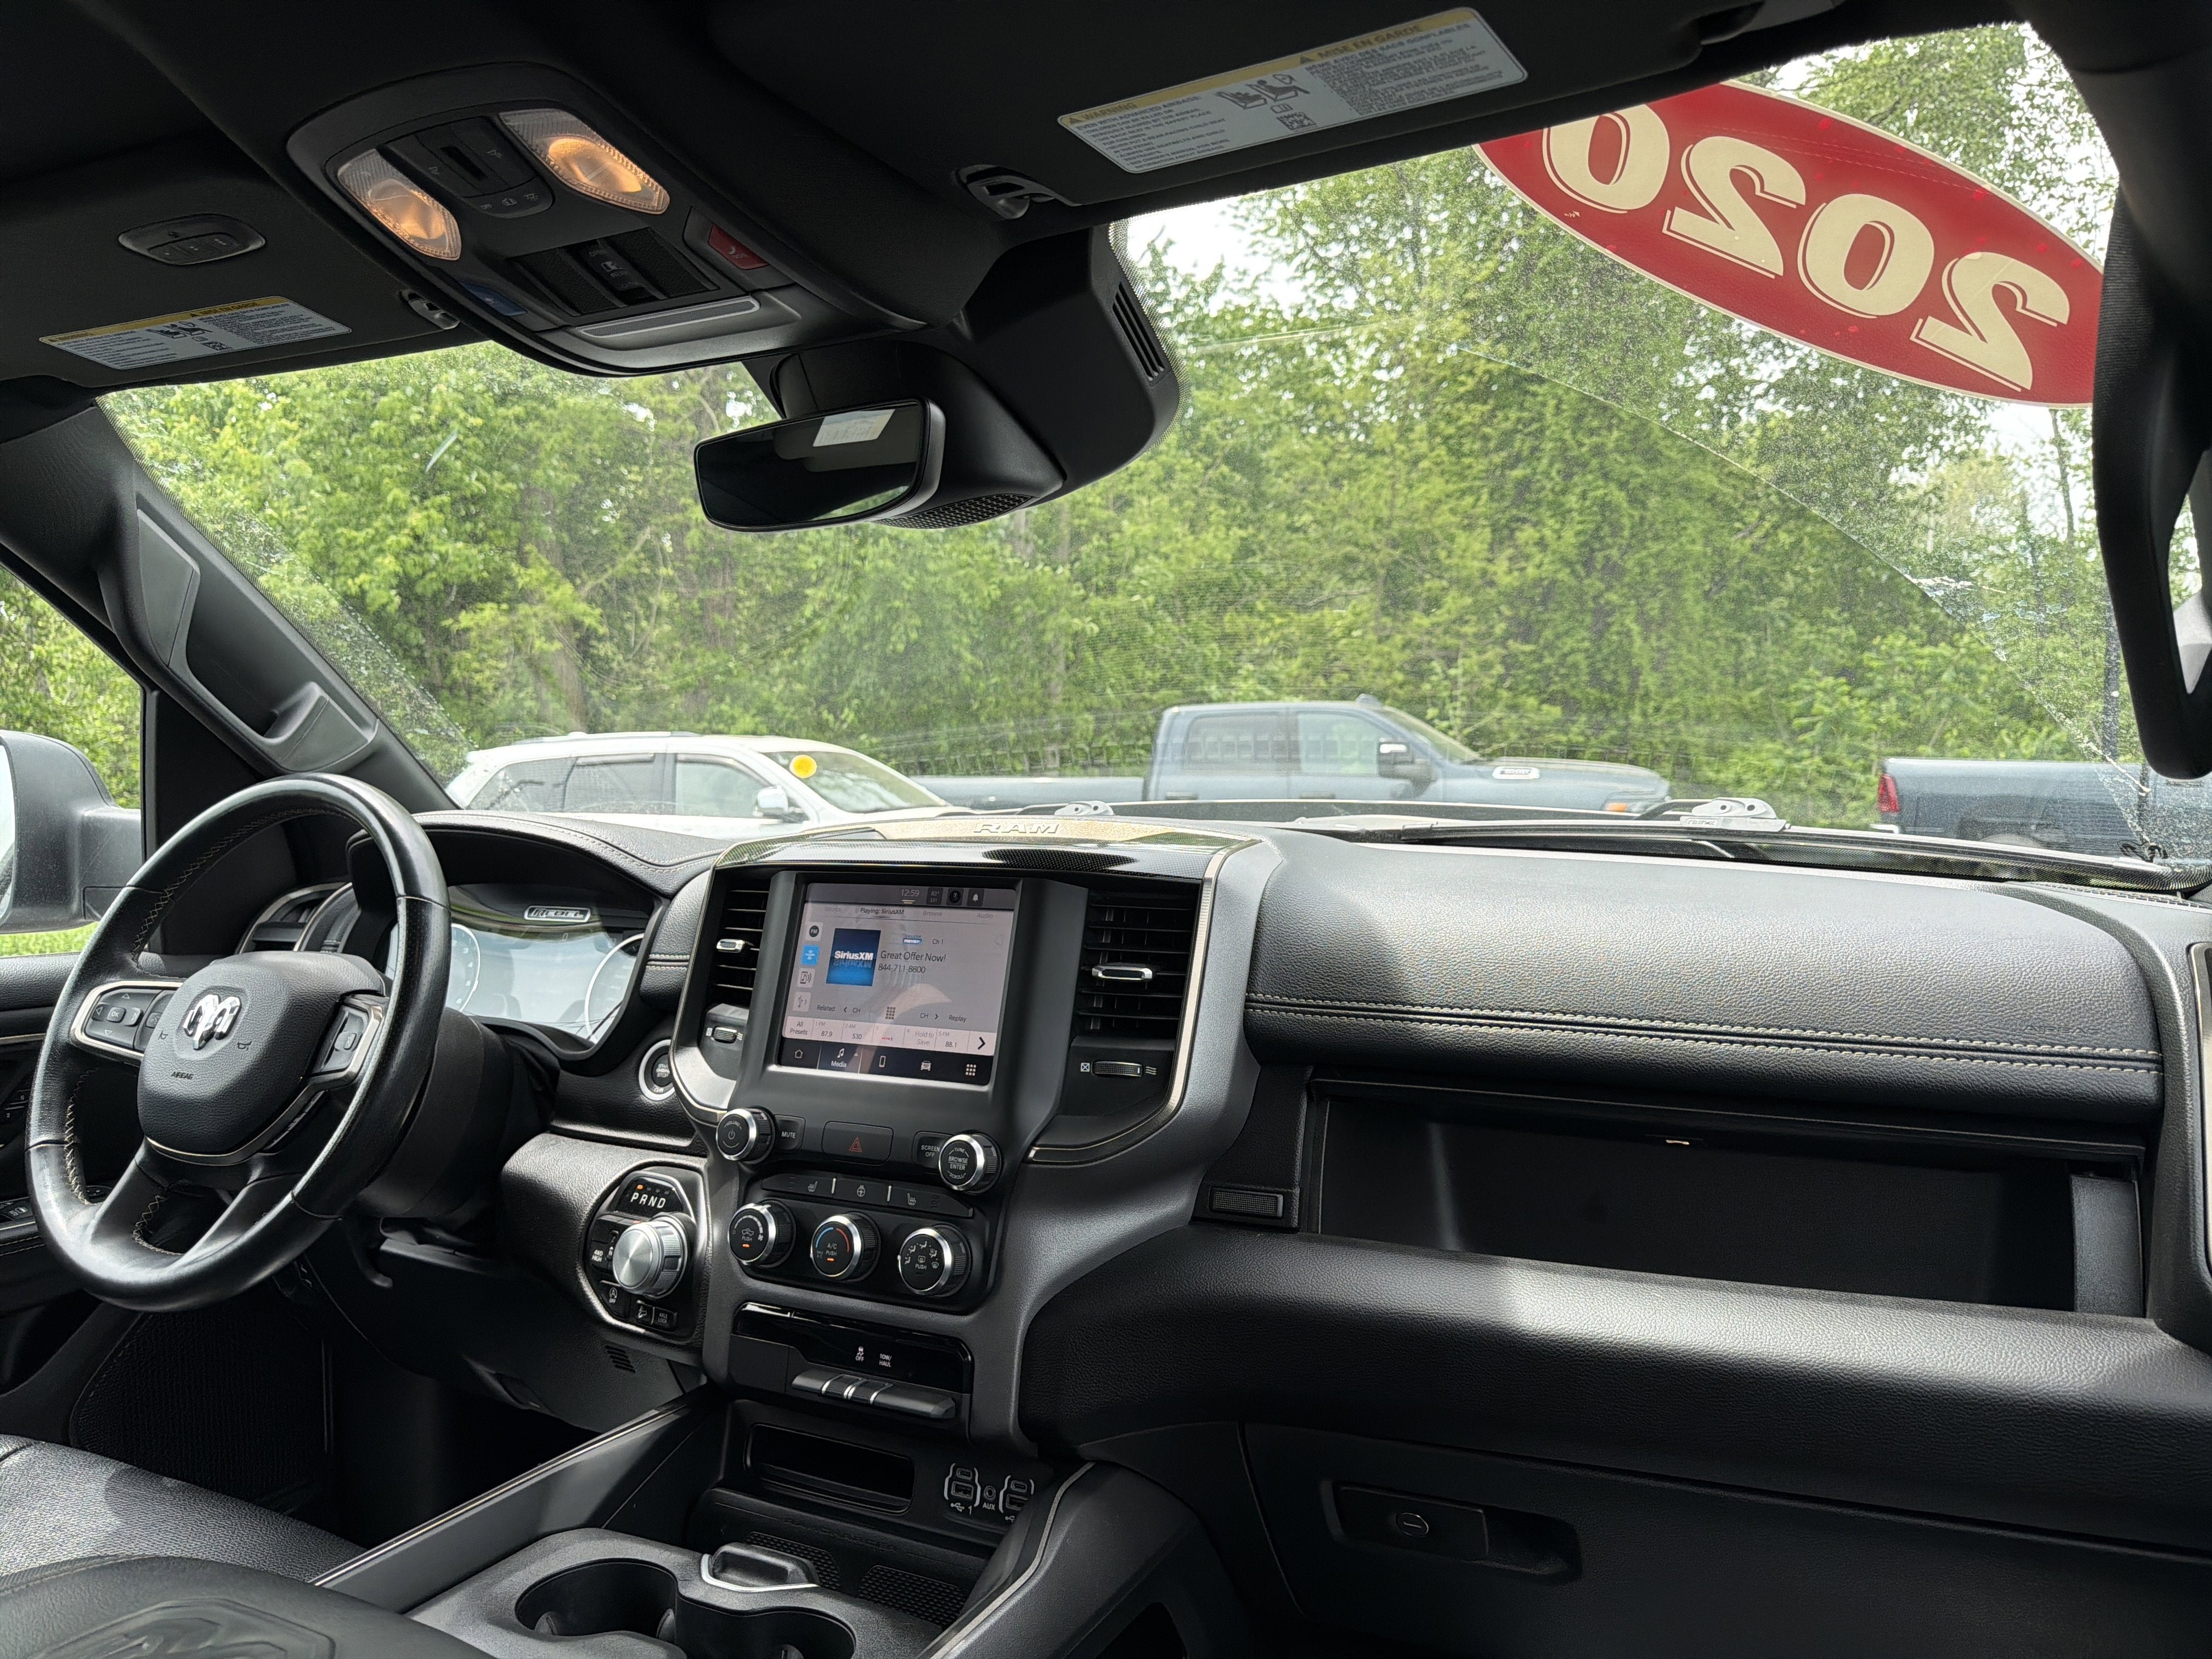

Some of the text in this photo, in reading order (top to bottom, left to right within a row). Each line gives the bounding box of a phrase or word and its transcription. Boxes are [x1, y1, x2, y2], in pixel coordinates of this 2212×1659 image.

[1317, 26, 1421, 58] MISE EN GARDE
[1080, 101, 1137, 120] WARNING
[973, 823, 1060, 834] RAM
[901, 889, 920, 897] 12:59
[531, 908, 585, 919] REBEL
[834, 950, 874, 962] SiriusXM
[880, 950, 947, 962] Great Offer Now!
[877, 963, 926, 974] 844-711-8800
[949, 1014, 967, 1023] Replay
[789, 1028, 808, 1036] Presets
[831, 1060, 848, 1068] Media
[171, 1071, 194, 1080] AIRBAG
[781, 1131, 797, 1139] MUTE
[921, 1144, 941, 1153] SCREEN
[948, 1155, 969, 1164] BROWSE
[950, 1163, 966, 1171] ENTER
[879, 1352, 893, 1361] TOW/
[878, 1359, 892, 1368] HAUL
[968, 1505, 973, 1515] 1
[982, 1502, 996, 1511] AUX
